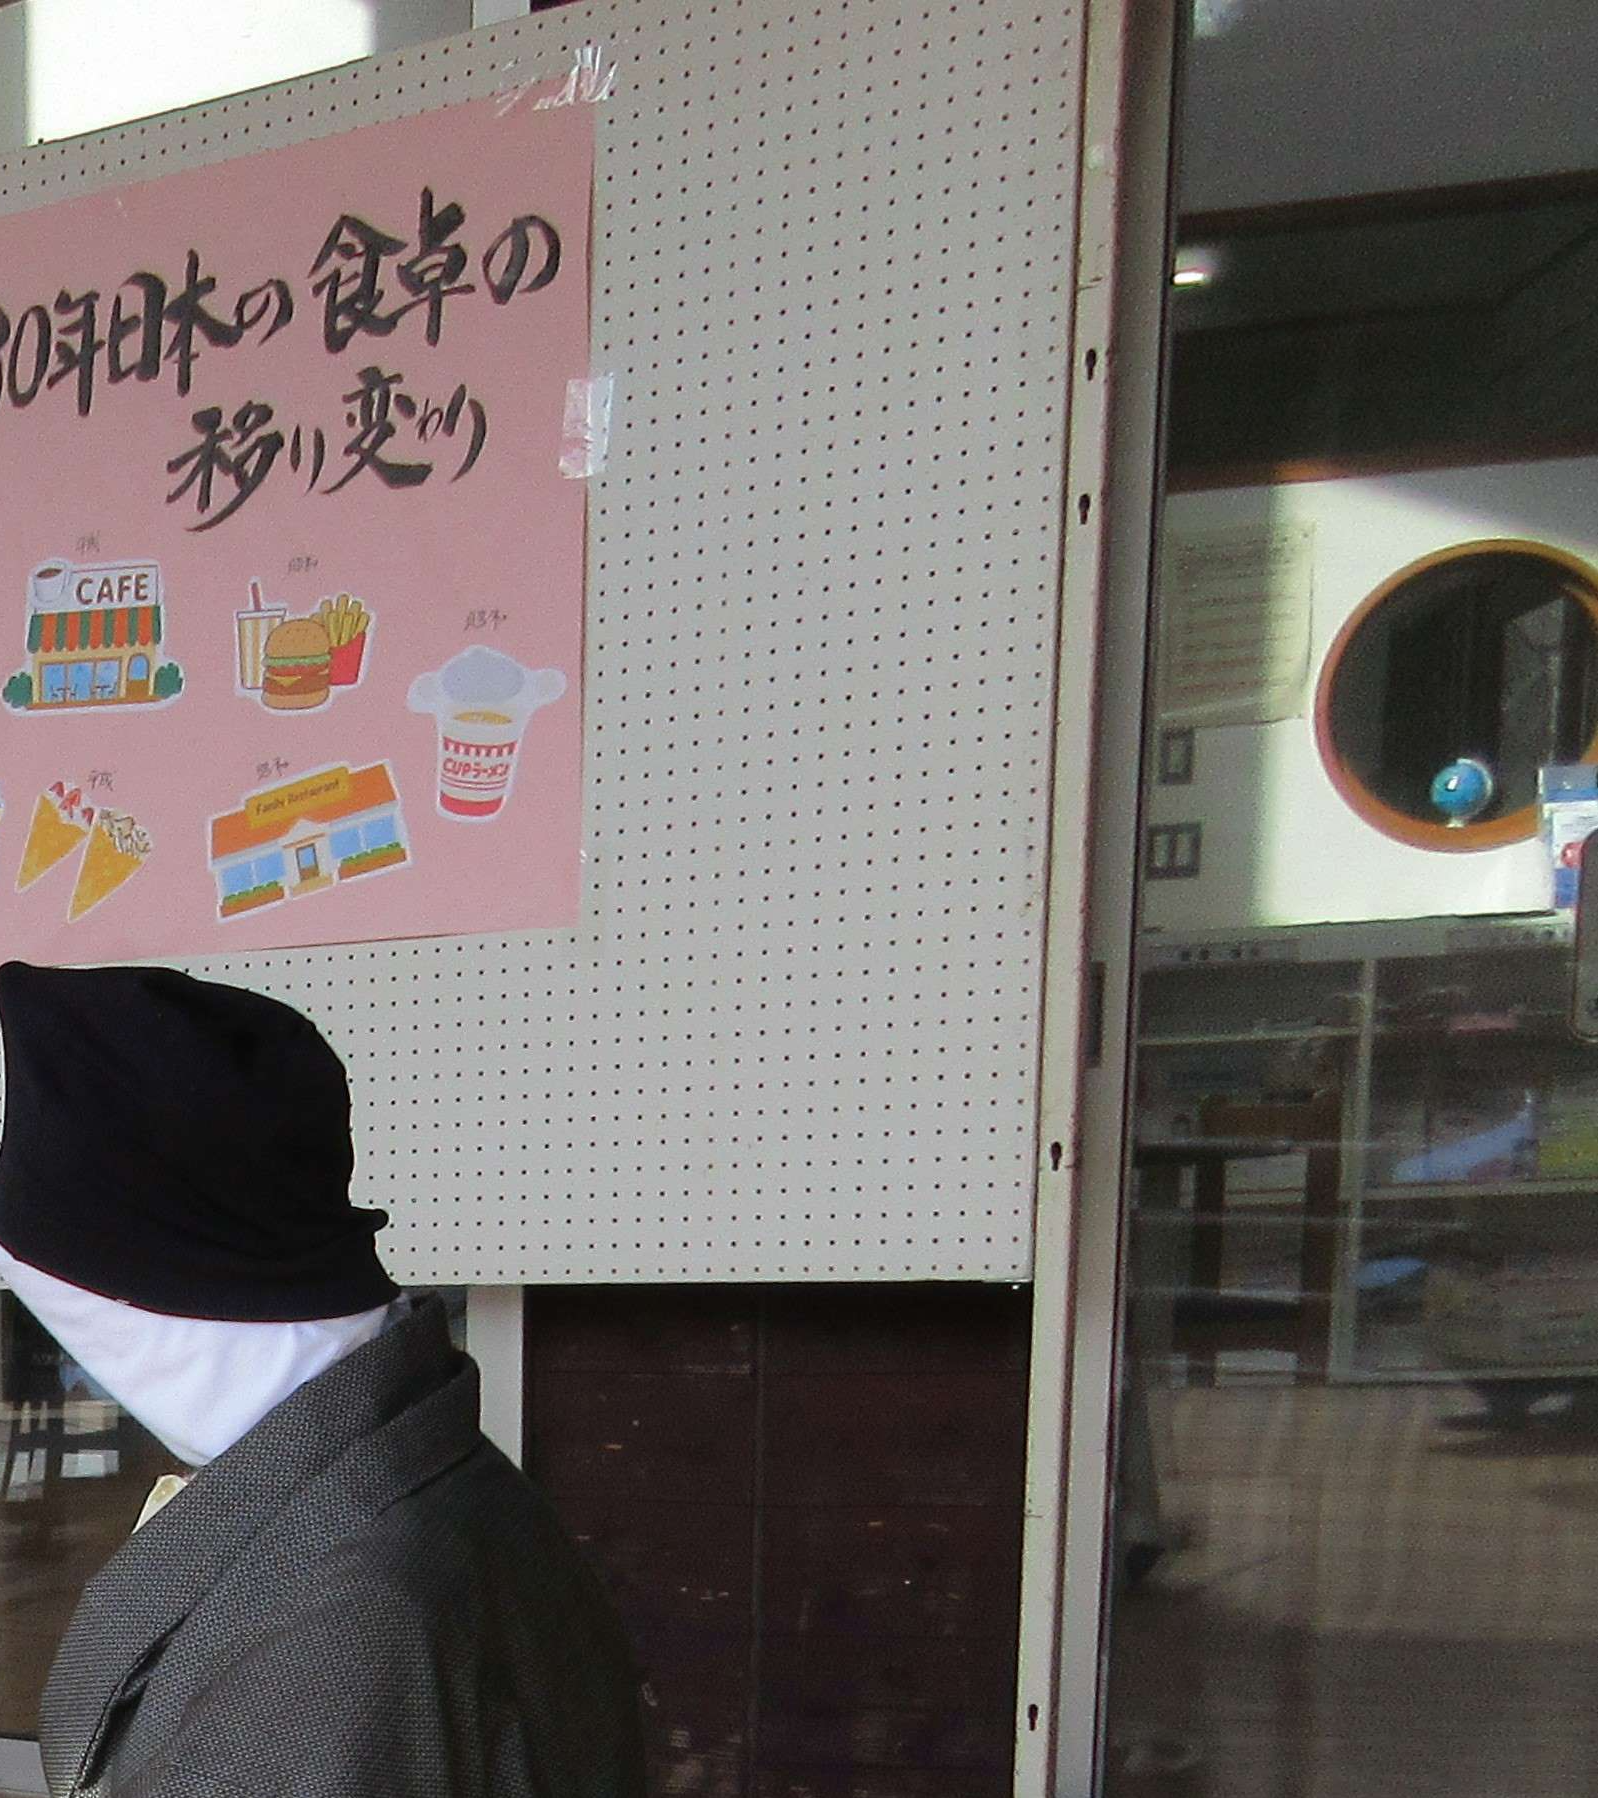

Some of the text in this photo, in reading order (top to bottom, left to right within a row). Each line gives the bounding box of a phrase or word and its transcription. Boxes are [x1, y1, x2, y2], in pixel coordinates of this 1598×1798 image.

[165, 366, 487, 532] 移り変わり
[75, 572, 150, 606] CAFE
[442, 755, 511, 781] CUPラーメン
